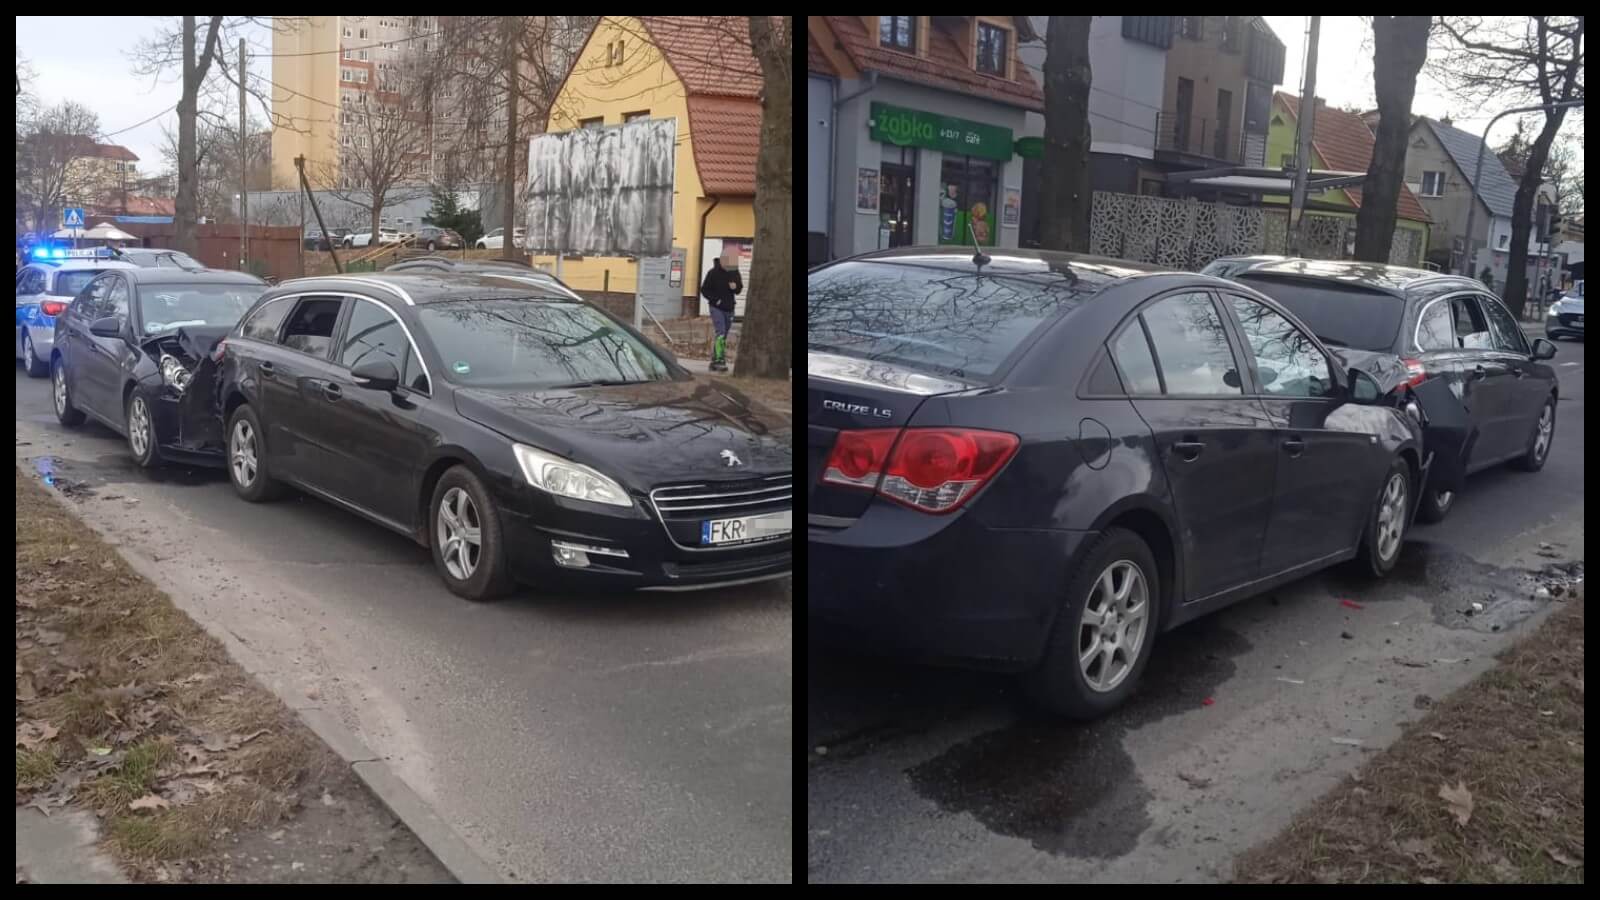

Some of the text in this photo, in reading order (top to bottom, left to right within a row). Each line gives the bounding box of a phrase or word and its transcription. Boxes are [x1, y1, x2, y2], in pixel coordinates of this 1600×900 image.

[823, 400, 892, 418] CRUZE LS
[711, 520, 742, 541] FKR
